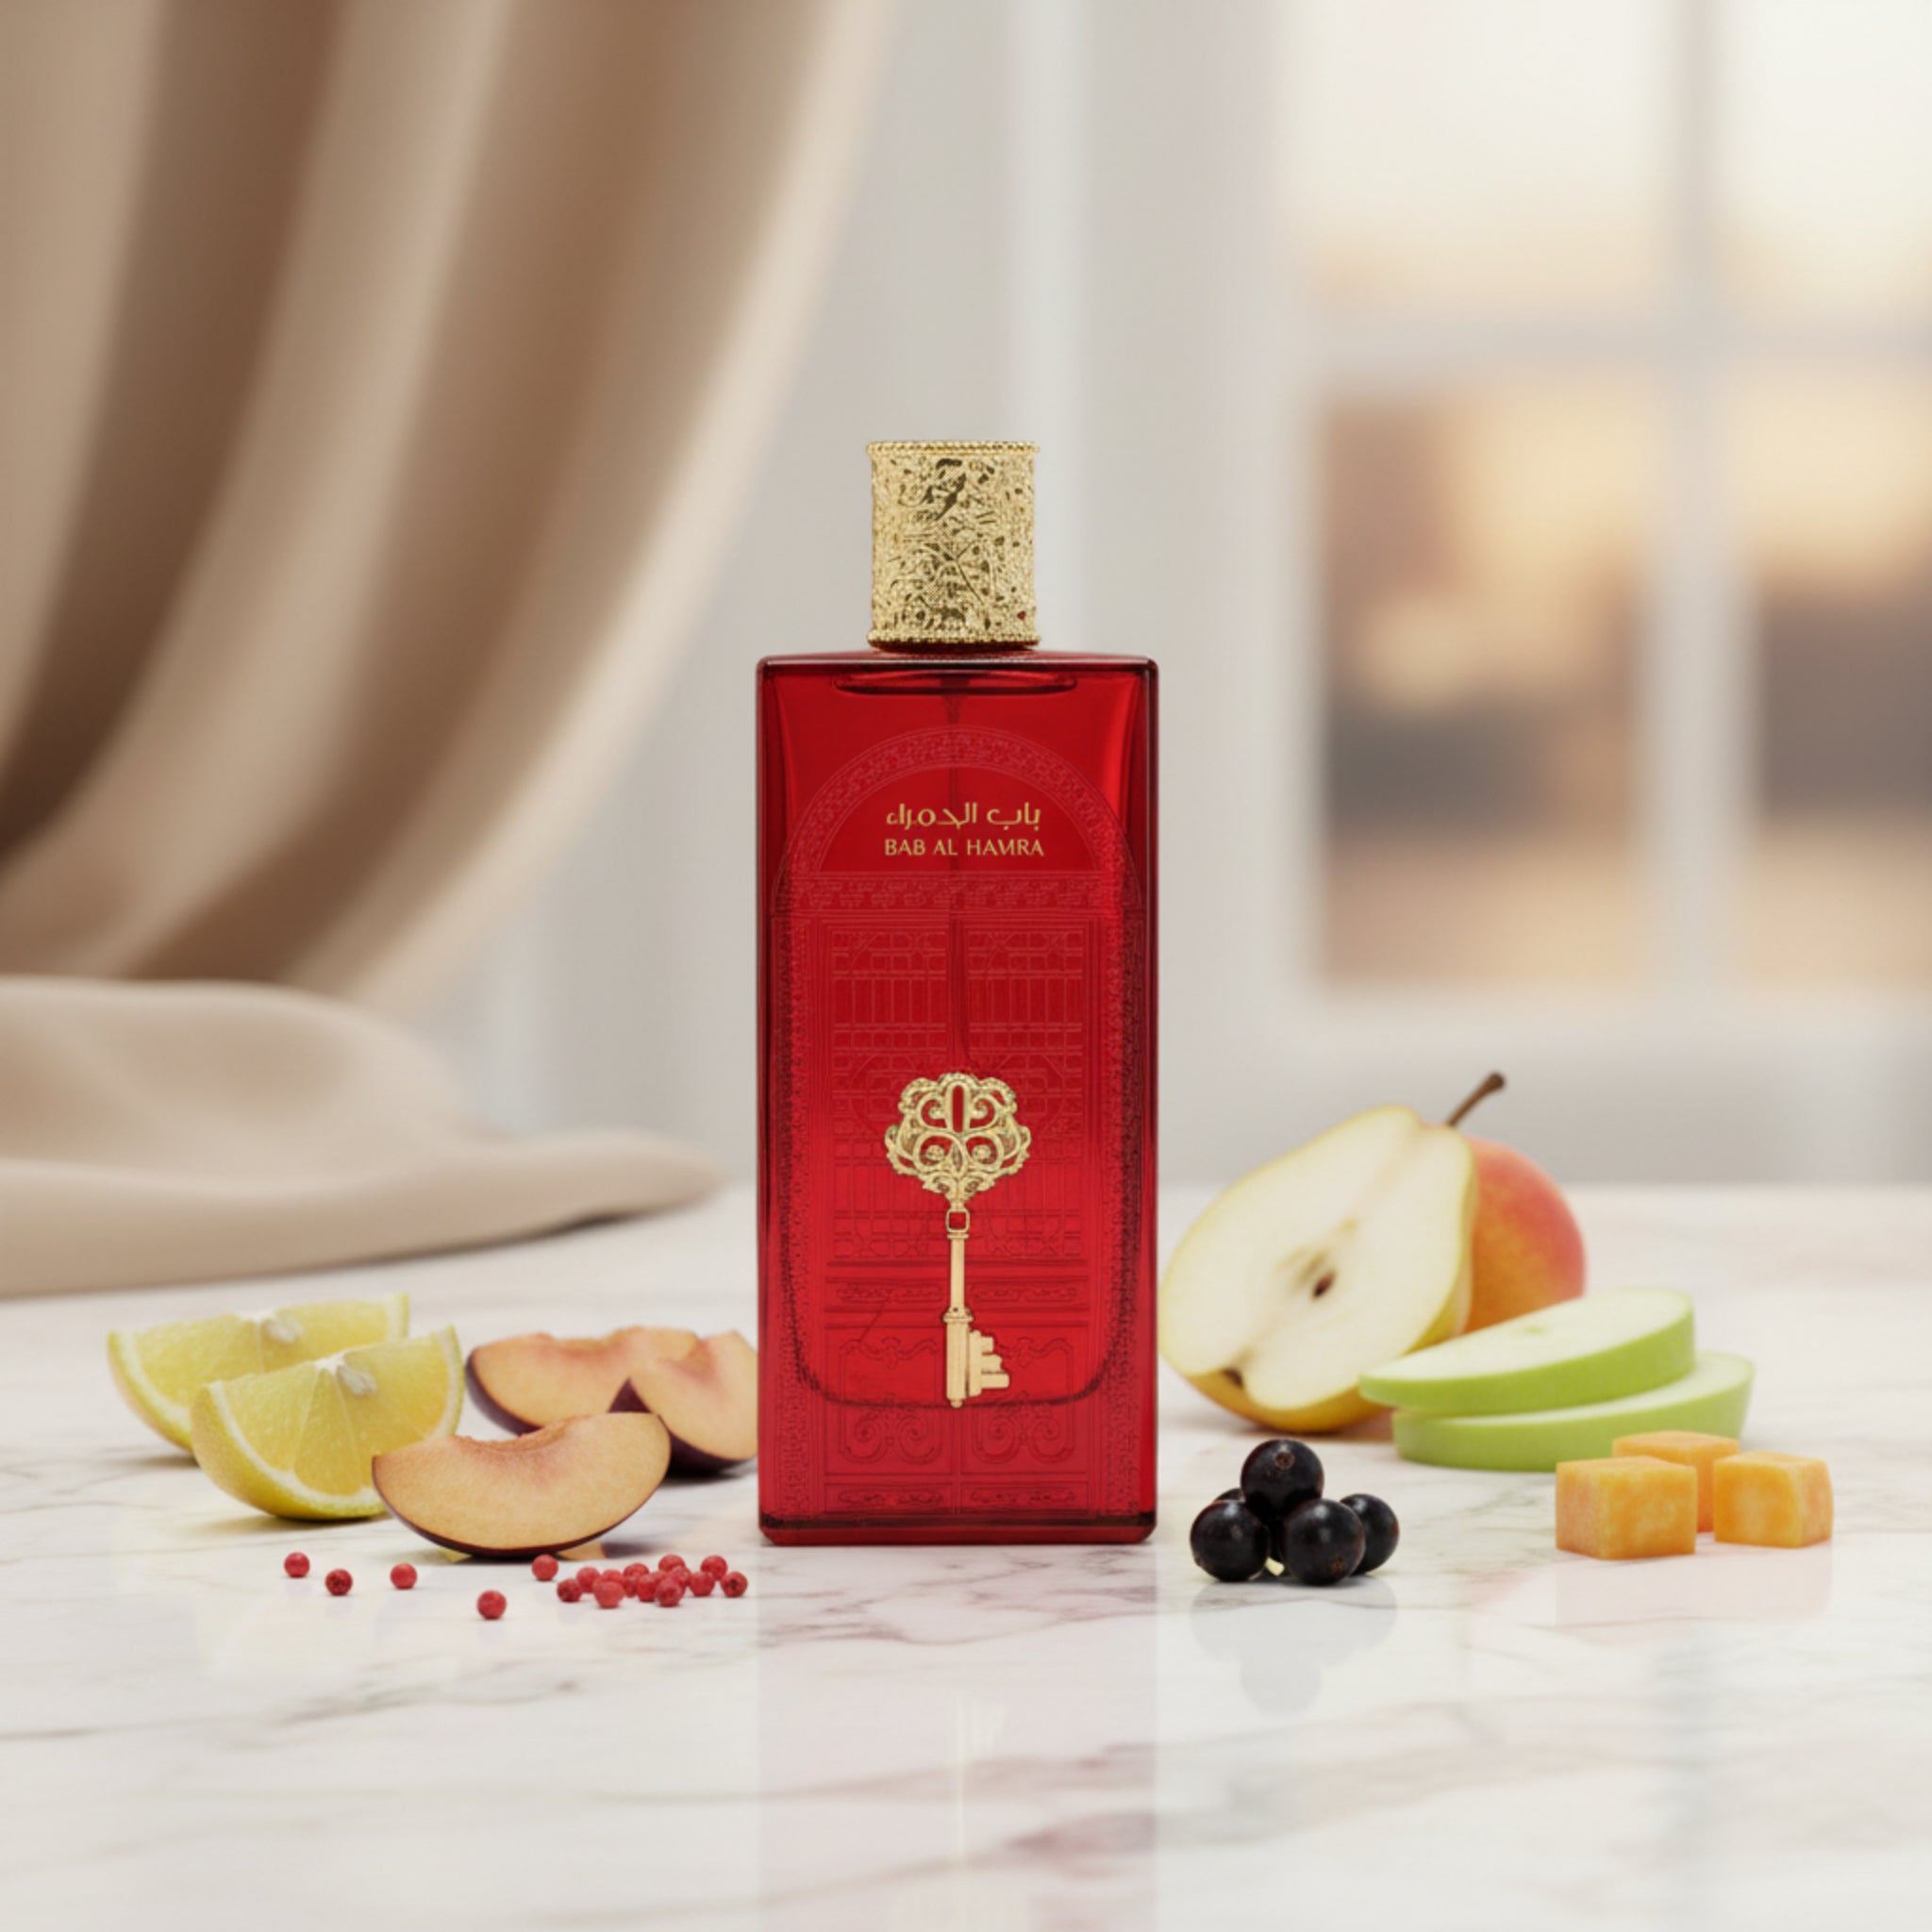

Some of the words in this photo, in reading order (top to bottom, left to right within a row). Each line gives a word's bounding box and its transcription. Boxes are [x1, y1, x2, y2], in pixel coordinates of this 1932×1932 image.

[886, 802, 977, 831] الحمراء
[987, 802, 1041, 832] باب
[885, 839, 926, 857] BAB
[933, 839, 958, 857] AL
[967, 839, 1045, 857] HAMRA
